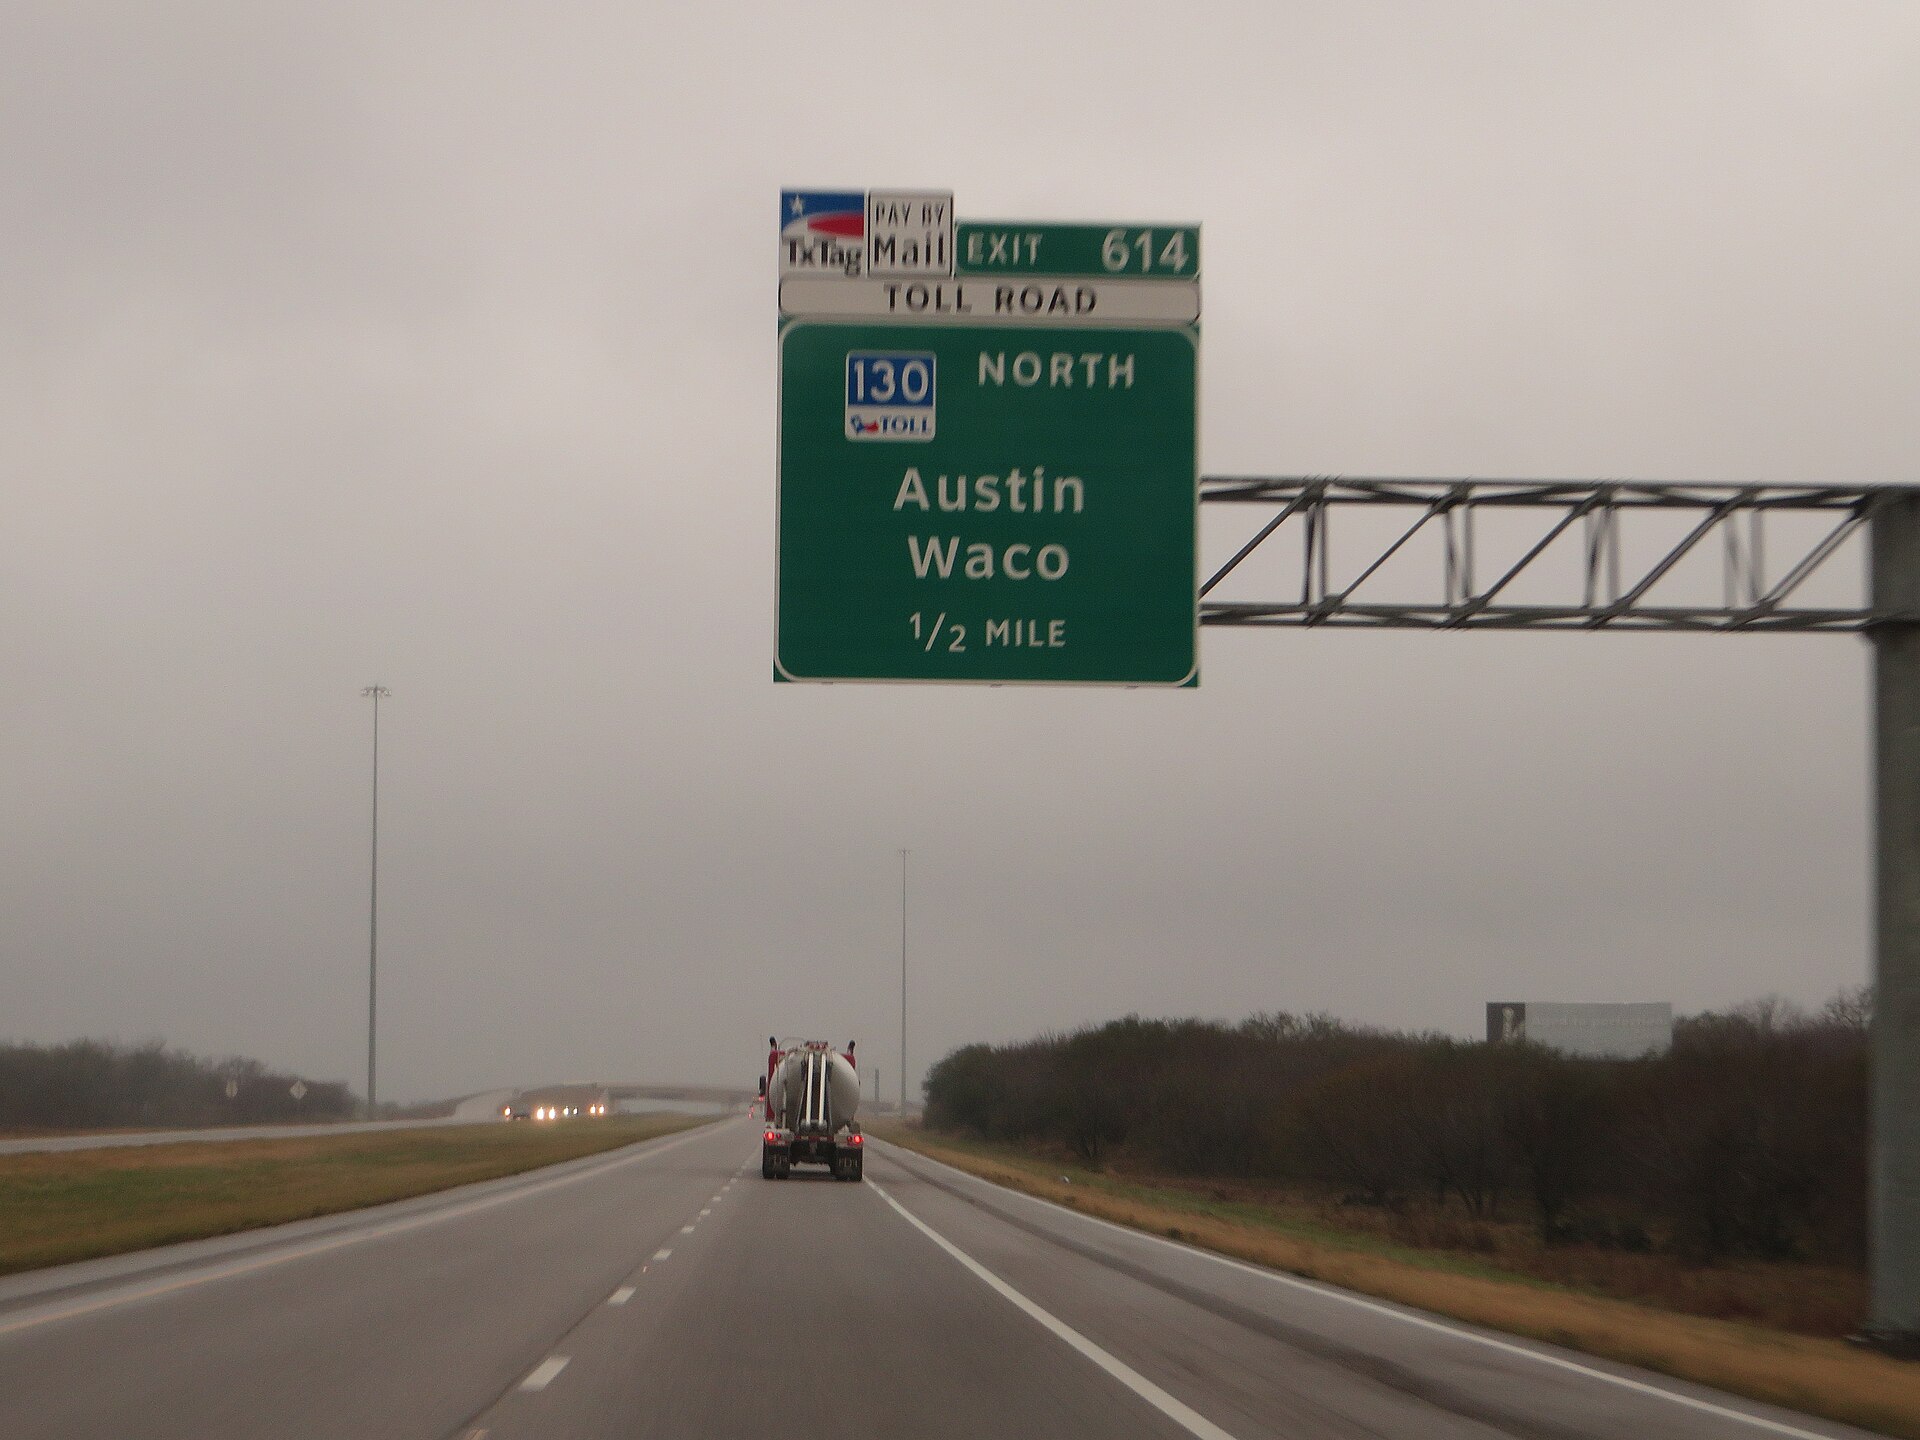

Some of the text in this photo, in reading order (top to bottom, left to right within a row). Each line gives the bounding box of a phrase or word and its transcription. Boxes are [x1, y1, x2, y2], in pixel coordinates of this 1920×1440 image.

[875, 201, 945, 227] PAY BY
[783, 236, 862, 276] TxTag
[874, 232, 945, 267] Mail
[967, 232, 1043, 266] EXIT
[1102, 228, 1189, 274] 614
[884, 282, 1097, 315] TOLL ROAD
[854, 359, 929, 402] 130
[978, 351, 1135, 388] NORTH
[880, 415, 933, 435] TOLL
[893, 465, 1085, 513] Austin
[907, 535, 1070, 580] Waco
[909, 611, 1067, 652] 1/2 MILE
